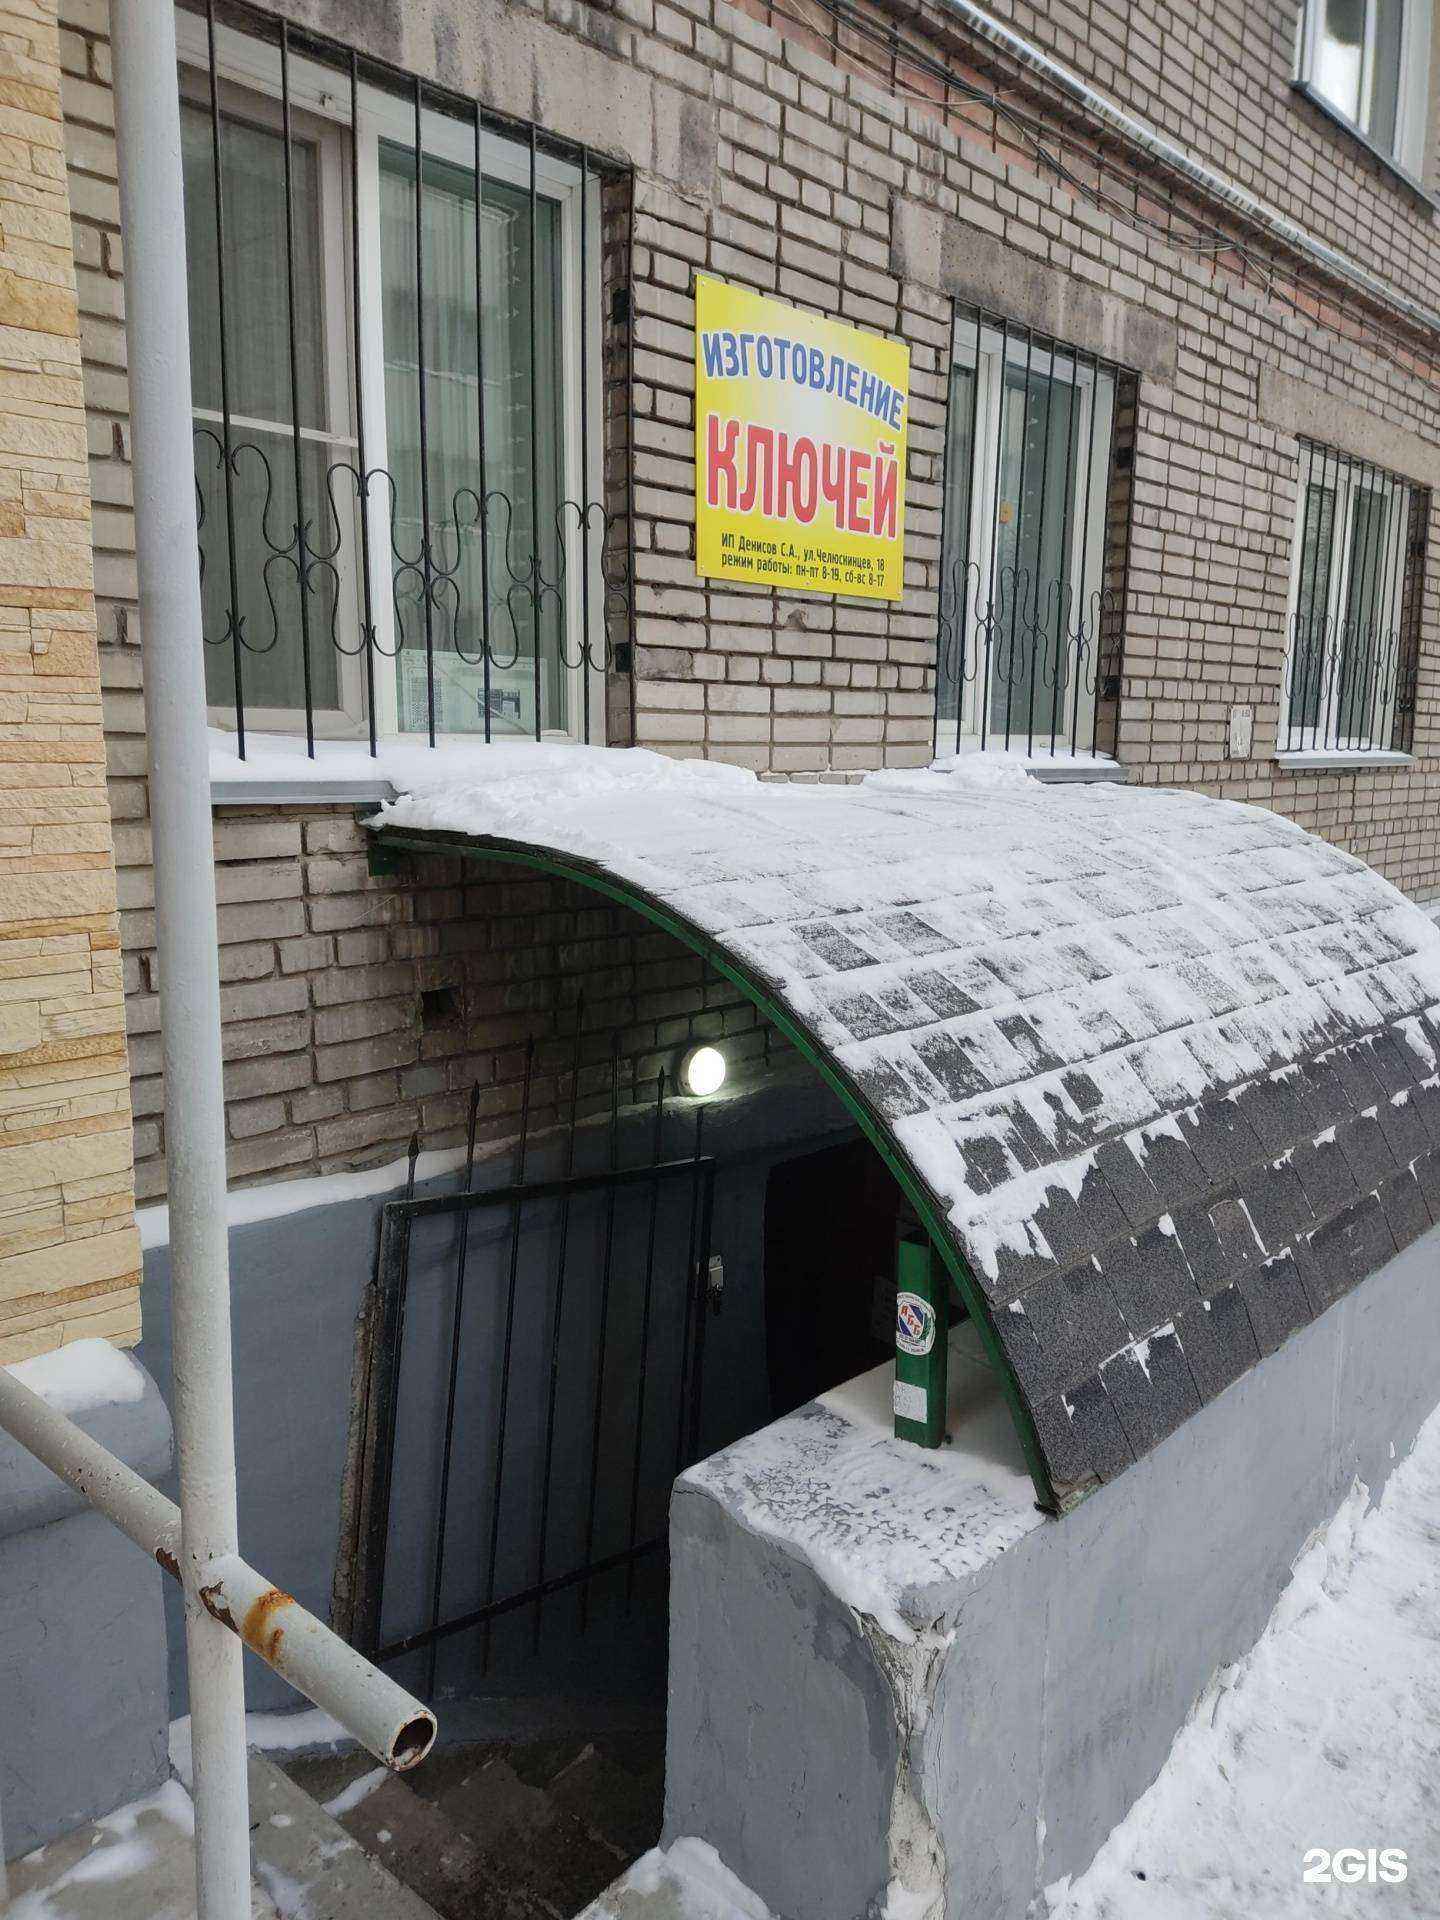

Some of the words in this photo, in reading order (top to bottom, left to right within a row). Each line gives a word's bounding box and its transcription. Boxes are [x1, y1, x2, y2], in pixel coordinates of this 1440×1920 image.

[702, 331, 905, 431] ИЗГОТОВЛЕНИЕ
[707, 414, 898, 538] КЛЮЧЕЙ
[721, 533, 735, 548] ИП
[738, 536, 777, 555] Денисов
[877, 558, 885, 571] 18
[721, 553, 753, 569] режим
[757, 558, 792, 574] работы:
[796, 564, 819, 578] пн-пт
[845, 570, 866, 585] сб-вс
[868, 573, 885, 587] 8-17
